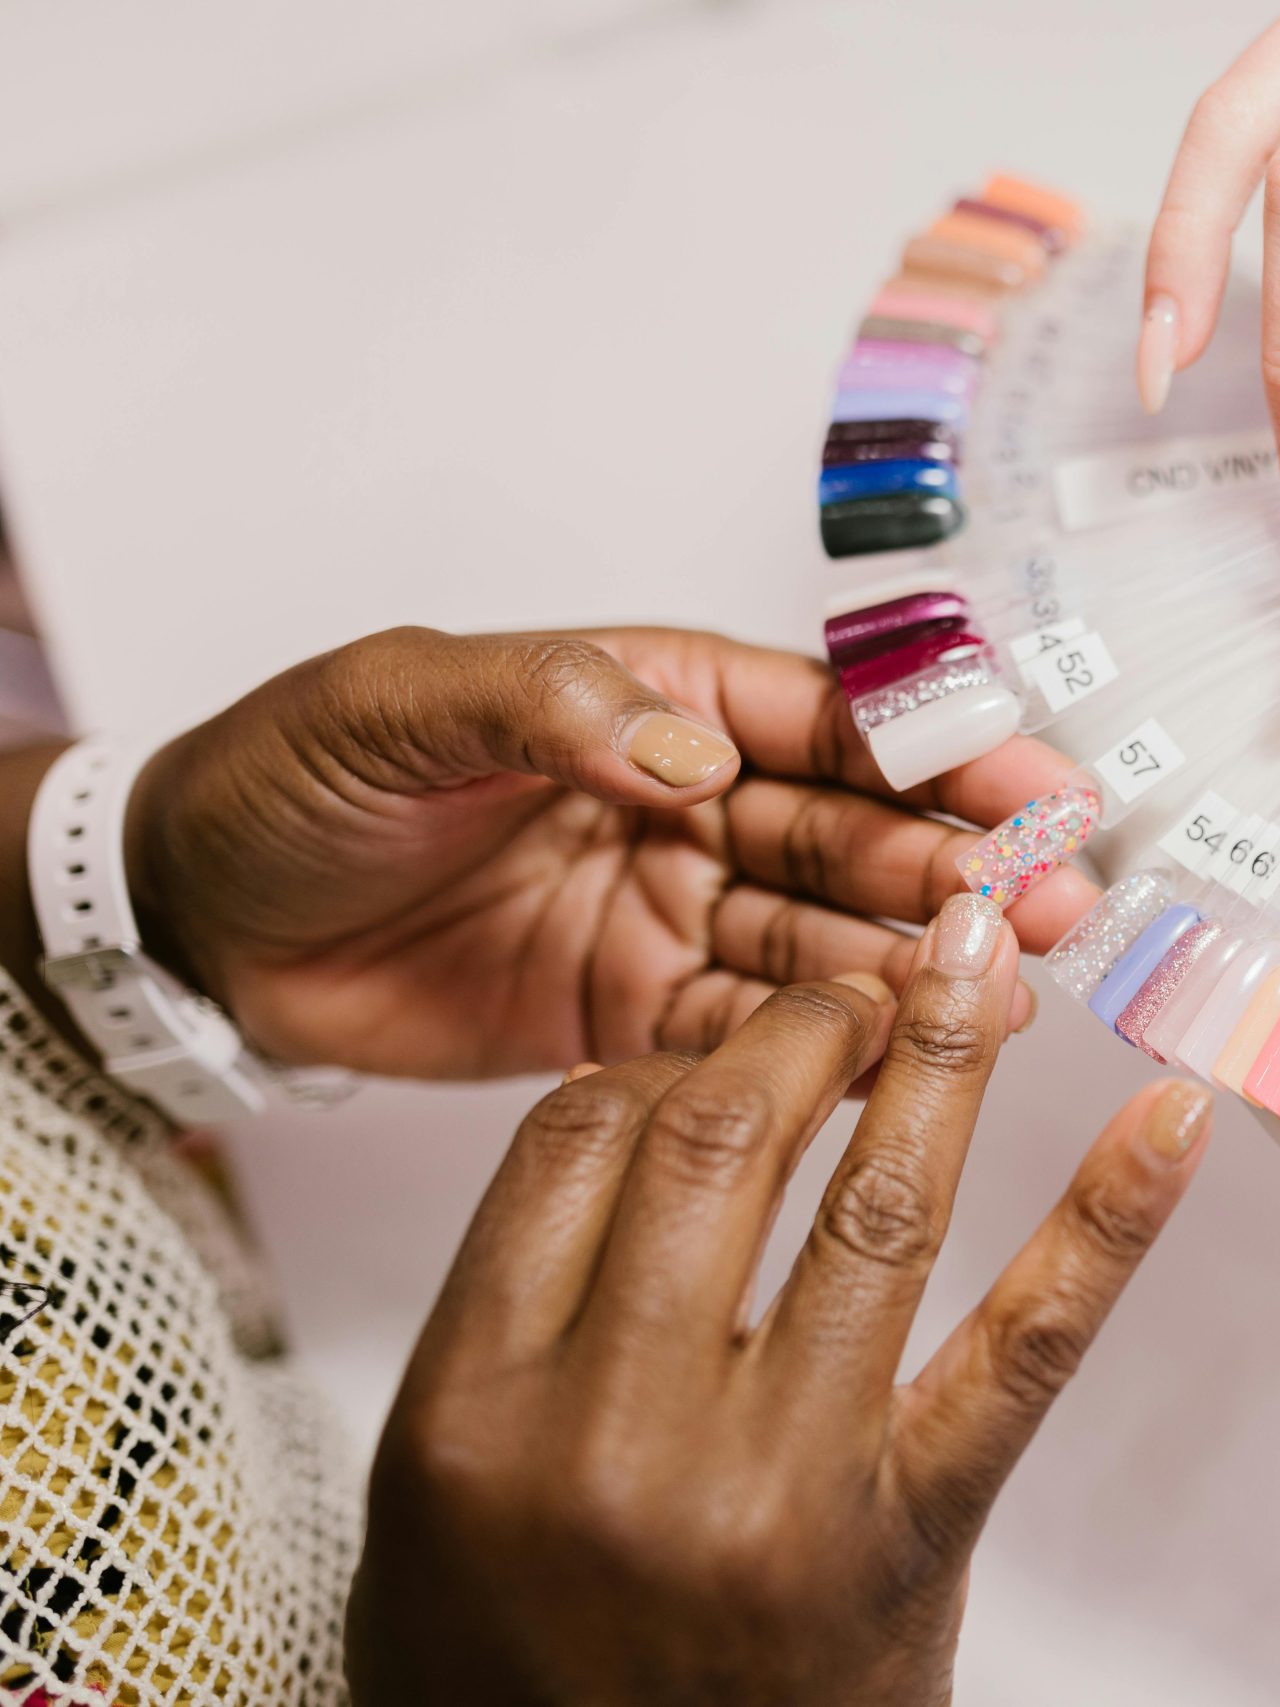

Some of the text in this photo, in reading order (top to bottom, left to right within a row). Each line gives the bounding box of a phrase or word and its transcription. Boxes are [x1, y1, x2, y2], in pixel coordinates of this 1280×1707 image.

[1057, 650, 1094, 695] 52
[1119, 740, 1161, 777] 57
[1186, 814, 1228, 856] 54
